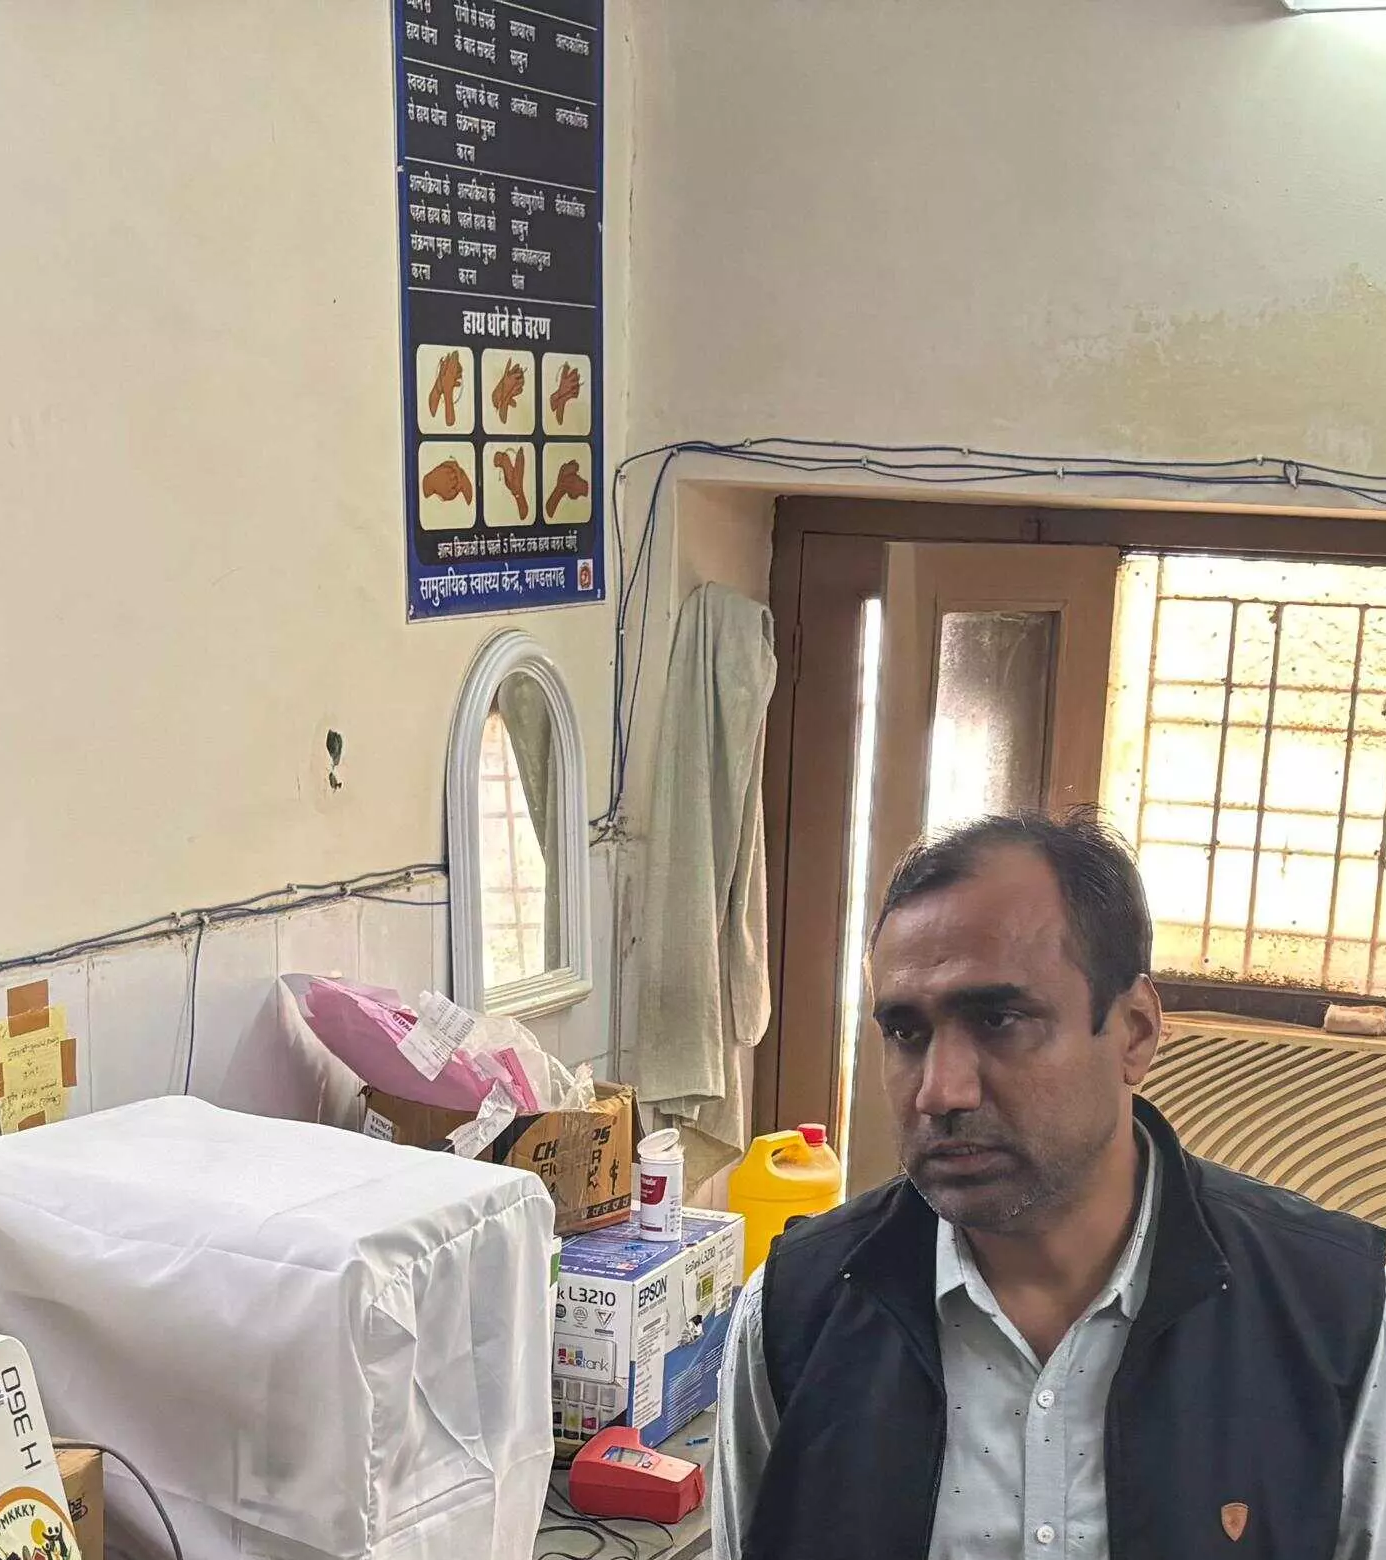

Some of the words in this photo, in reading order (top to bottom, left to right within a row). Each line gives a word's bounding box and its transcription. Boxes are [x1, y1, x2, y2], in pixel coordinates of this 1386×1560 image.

[462, 309, 486, 337] हाथ
[487, 307, 510, 338] धोने
[511, 307, 524, 337] के
[524, 314, 551, 341] चरण
[419, 566, 468, 607] सामुदायिक
[469, 571, 500, 595] स्वास्थ्य
[569, 1287, 616, 1307] L3210
[638, 1275, 668, 1309] EPSON
[1, 1366, 33, 1437] 360
